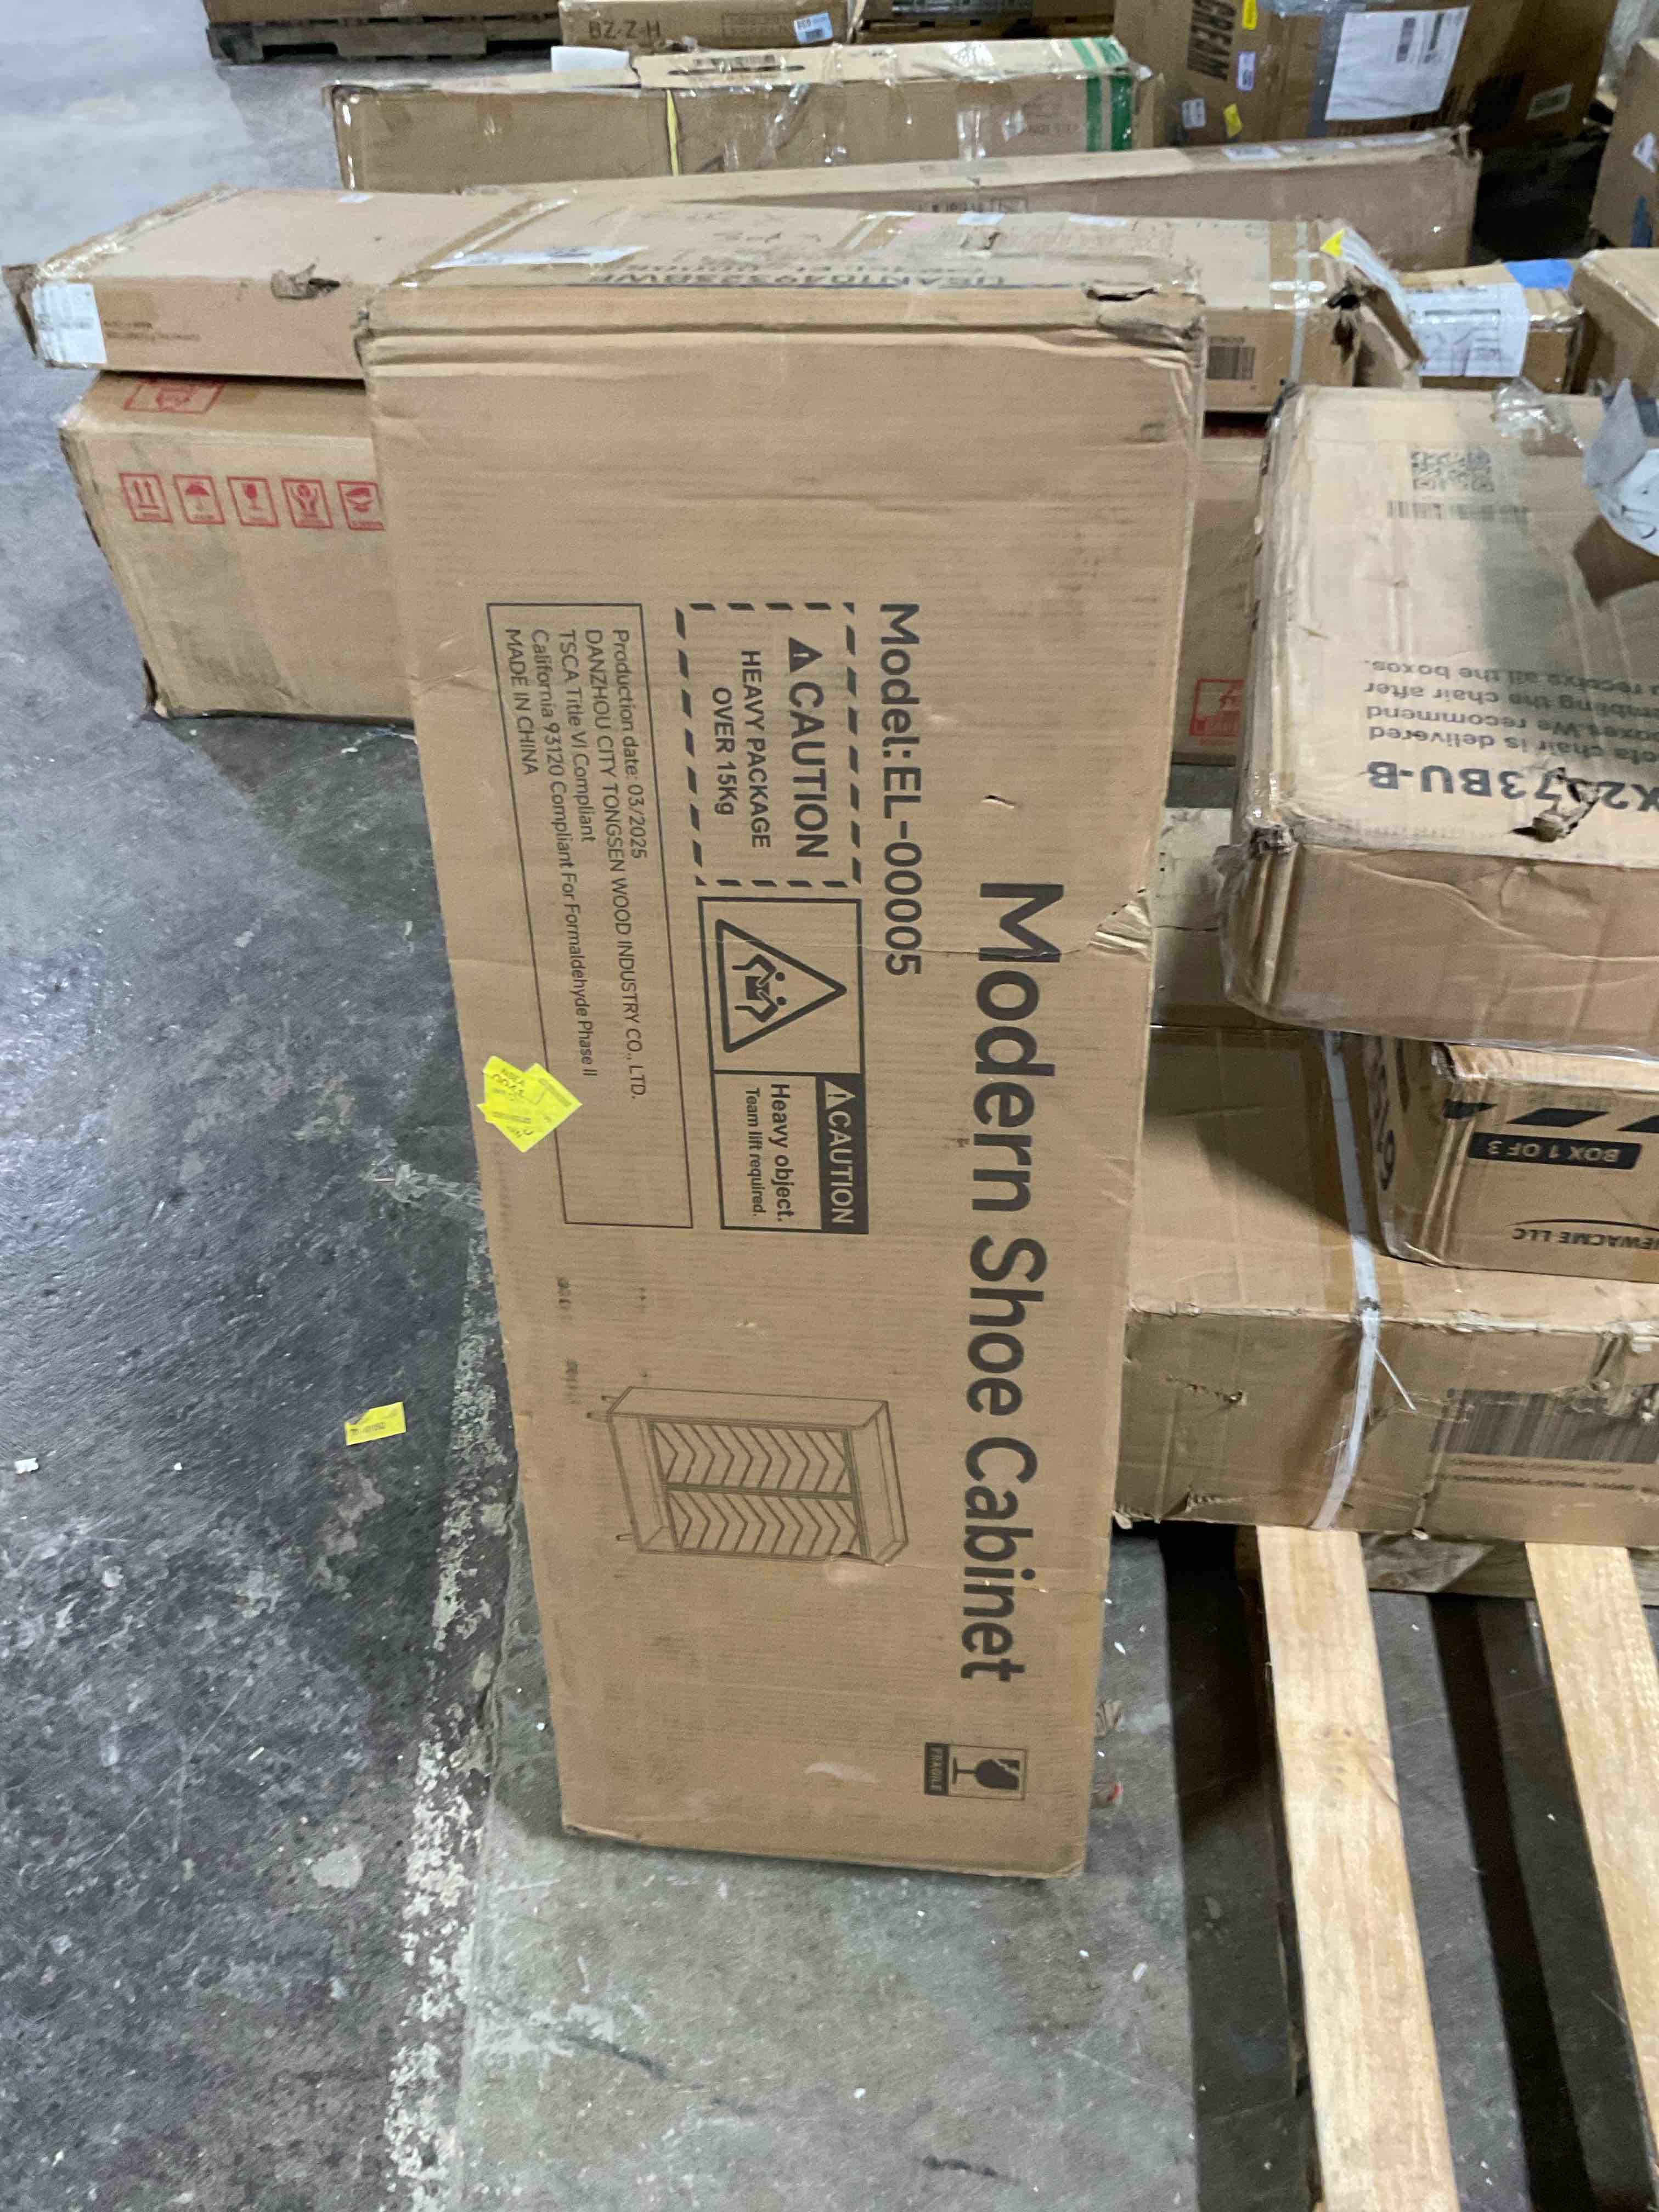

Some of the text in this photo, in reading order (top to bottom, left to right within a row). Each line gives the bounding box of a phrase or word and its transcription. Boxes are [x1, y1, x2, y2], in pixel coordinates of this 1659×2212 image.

[505, 628, 539, 775] MADE IN CHINA
[531, 629, 555, 718] California
[584, 629, 610, 730] DANZHOU
[1364, 682, 1425, 699] after
[1432, 687, 1499, 706] chair
[1459, 666, 1499, 683] the
[541, 722, 563, 776] 93120
[558, 629, 597, 842] TSCA Title VI Compliant
[613, 629, 647, 859] Production date: 03/2025
[712, 687, 738, 816] OVER 15Kg
[741, 650, 771, 848] HEAVY PACKAGE
[1366, 706, 1527, 730] recommend
[1369, 726, 1495, 749] delivered
[1504, 736, 1528, 752] is
[593, 735, 616, 777] CITY
[789, 681, 829, 859] CAUTION
[1367, 760, 1659, 811] X273BU-B
[550, 781, 575, 867] Compliant
[602, 783, 625, 872] TONGSEN
[561, 872, 577, 900] For
[612, 877, 633, 935] WOOD
[565, 903, 591, 1017] Formaldehyde
[617, 940, 641, 1024] INDUSTRY
[578, 1020, 594, 1065] Phase
[628, 1065, 646, 1099] LTD.
[746, 1087, 766, 1216] Team lift required.
[768, 1084, 795, 1222] Heavy object.
[827, 1110, 855, 1224] CAUTION
[1487, 1140, 1620, 1163] BOX 1 OF 3
[1511, 1227, 1551, 1241] LLC
[961, 882, 1064, 1683] Modern Shoe Cabinet
[928, 1747, 943, 1792] FRAGILE
